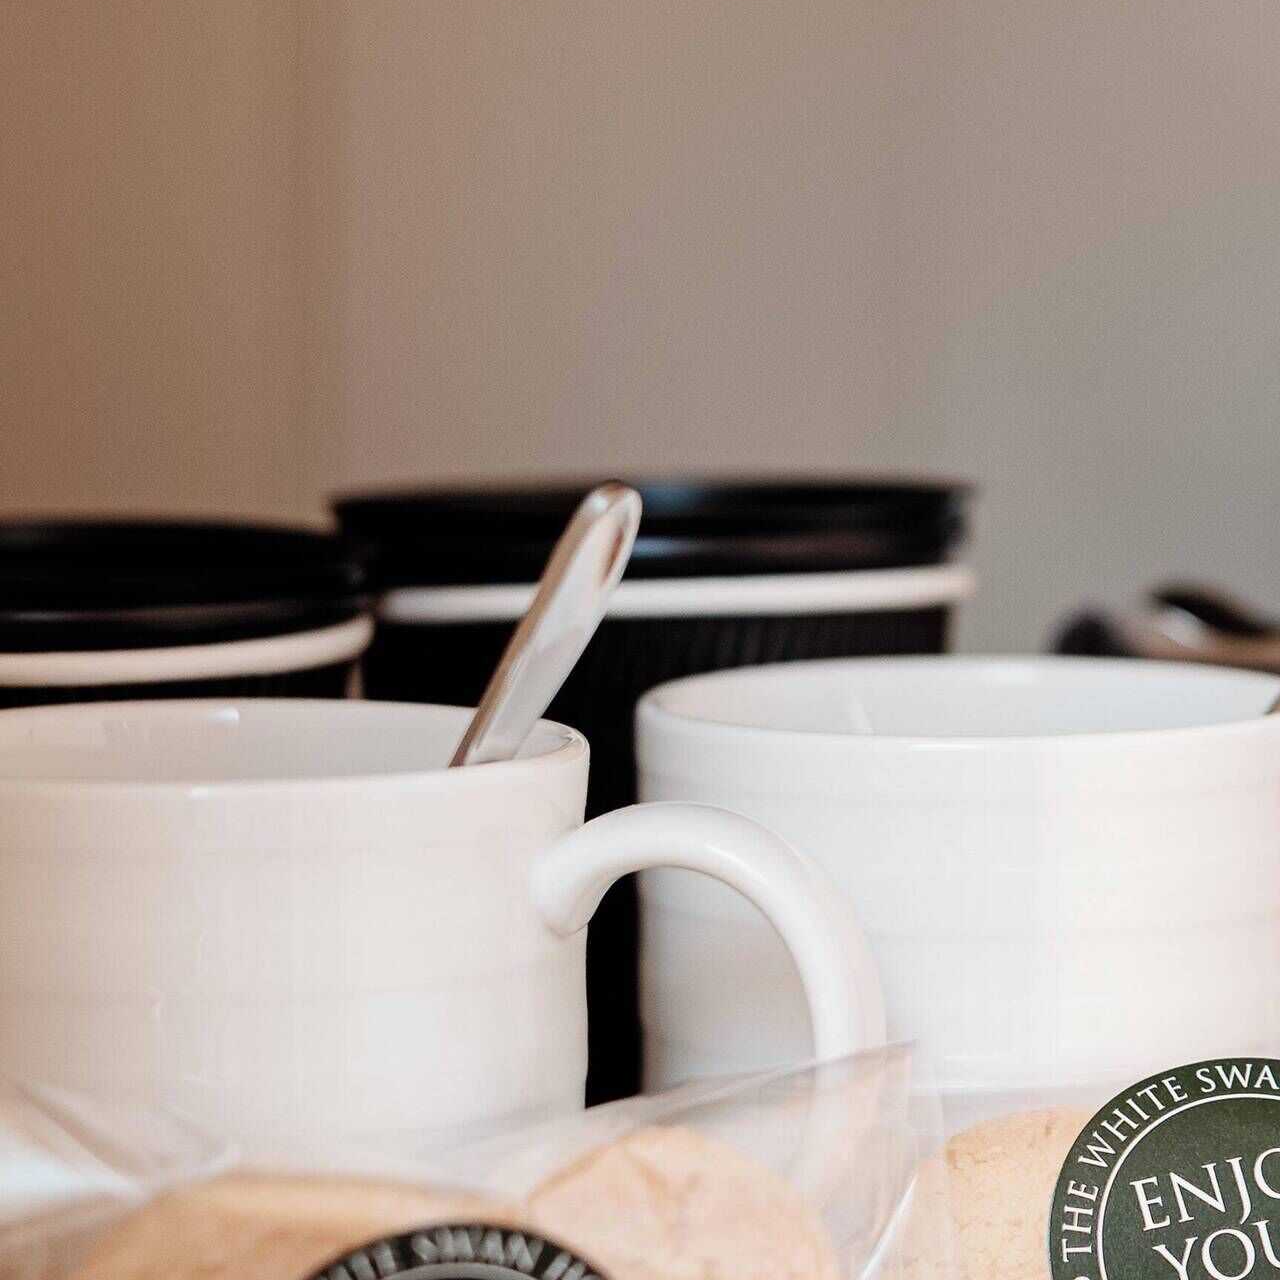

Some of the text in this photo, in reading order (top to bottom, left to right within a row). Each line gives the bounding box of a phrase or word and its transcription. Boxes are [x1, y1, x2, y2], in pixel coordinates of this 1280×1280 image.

[1079, 1076, 1188, 1172] WHITE
[410, 1226, 545, 1273] SWAN
[1062, 1180, 1100, 1262] THE
